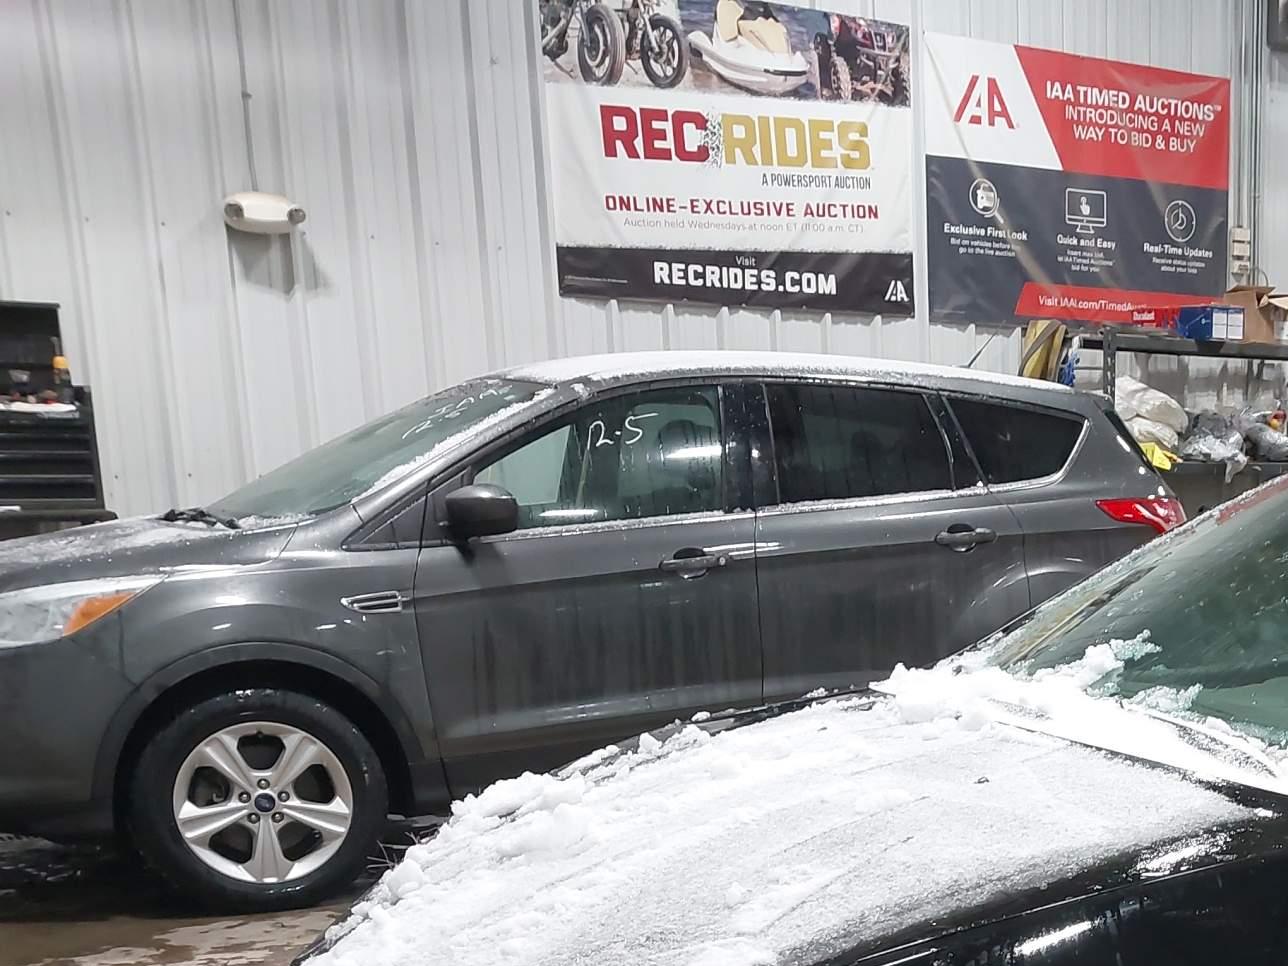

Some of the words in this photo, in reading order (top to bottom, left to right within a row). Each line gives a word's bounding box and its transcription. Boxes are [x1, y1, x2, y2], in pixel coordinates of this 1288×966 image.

[1046, 80, 1074, 103] IAA
[1076, 86, 1130, 109] TIMED
[1065, 105, 1158, 131] INTRODUCING
[1161, 122, 1171, 132] A
[1174, 122, 1205, 137] NEW
[1073, 124, 1105, 142] WAY
[1109, 128, 1128, 144] TO
[1131, 132, 1151, 148] BID
[1155, 135, 1165, 149] &
[1169, 138, 1197, 152] BUY
[762, 173, 768, 186] A
[770, 173, 831, 188] POWERSPORT
[834, 176, 871, 190] AUCTION
[605, 195, 796, 217] ONLINE-EXCLUSIVE
[803, 203, 880, 220] AUCTION
[623, 218, 661, 228] Auction
[663, 219, 685, 229] held
[688, 220, 746, 231] Wednesdays
[760, 223, 783, 231] noon
[943, 223, 985, 237] Exclusive
[987, 227, 1006, 240] First
[1057, 234, 1078, 246] Quick
[1079, 238, 1095, 247] and
[1096, 238, 1116, 250] Easy
[1143, 242, 1183, 256] Real-Time
[1183, 246, 1213, 258] Updates
[735, 256, 757, 267] Visit
[653, 261, 837, 295] RECRIDES.COM
[1038, 295, 1058, 307] Visit
